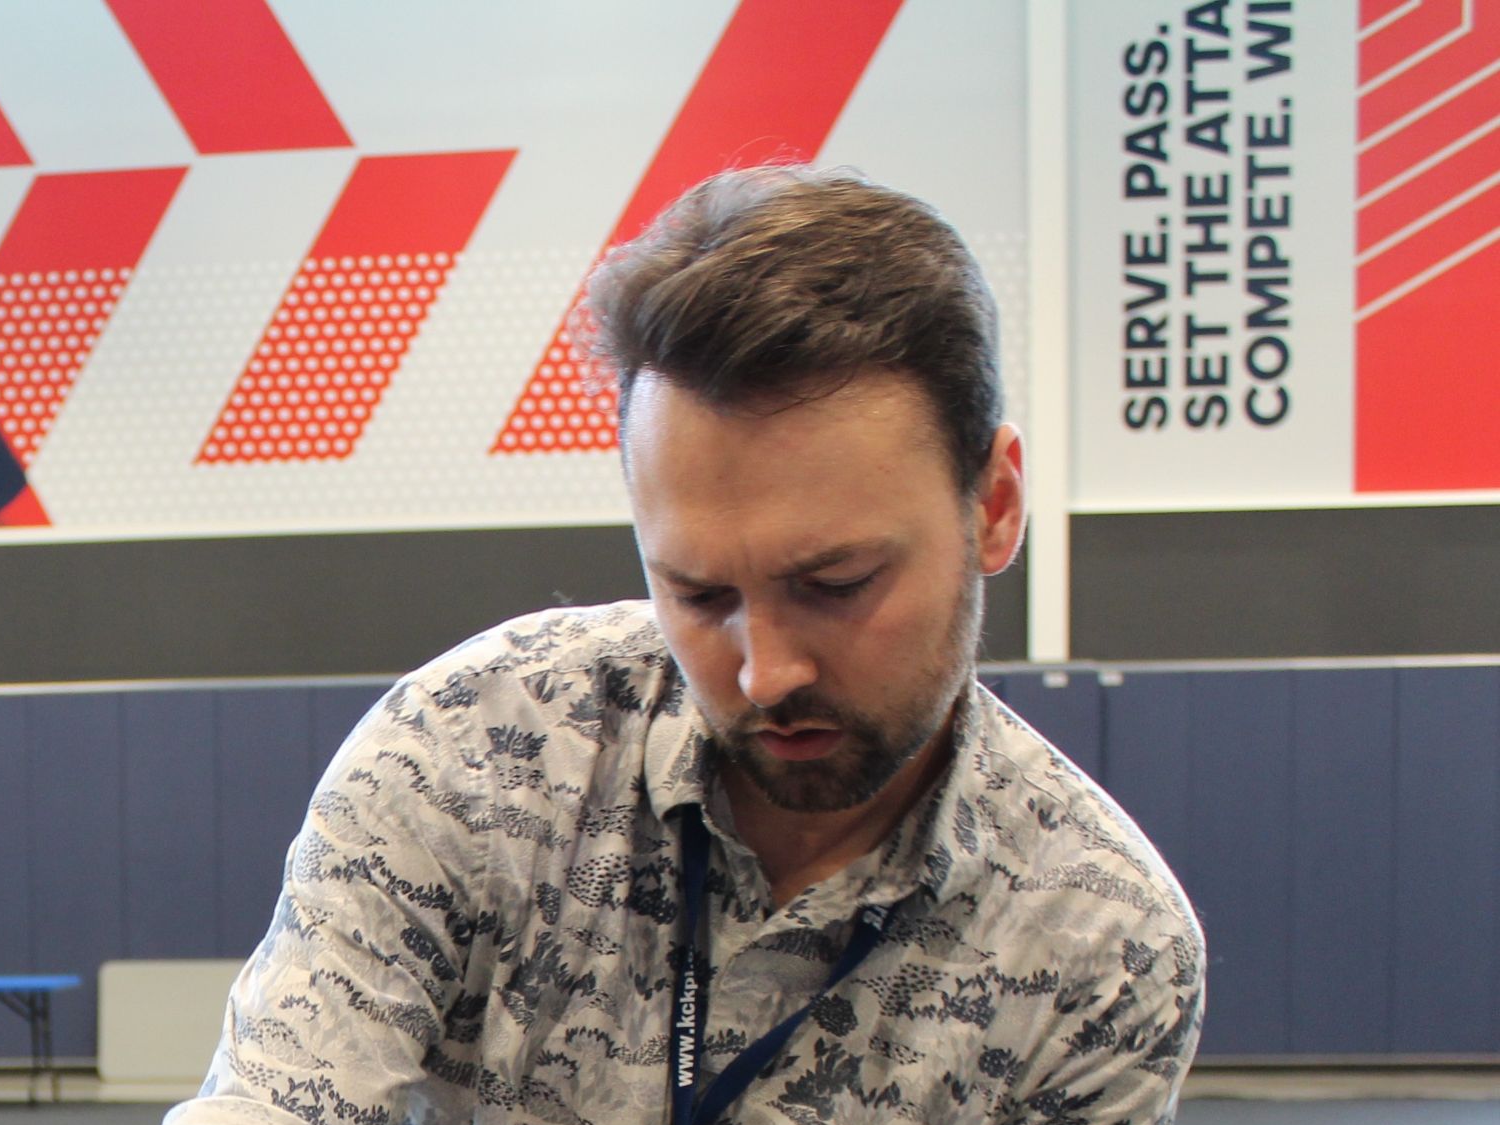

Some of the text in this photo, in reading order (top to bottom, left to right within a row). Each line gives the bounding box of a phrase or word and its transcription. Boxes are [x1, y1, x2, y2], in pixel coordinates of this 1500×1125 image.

[1122, 23, 1170, 431] SERVE. PASS.
[1183, 173, 1229, 297] THE
[1245, 98, 1292, 428] COMPETE.
[1183, 314, 1229, 431] SET
